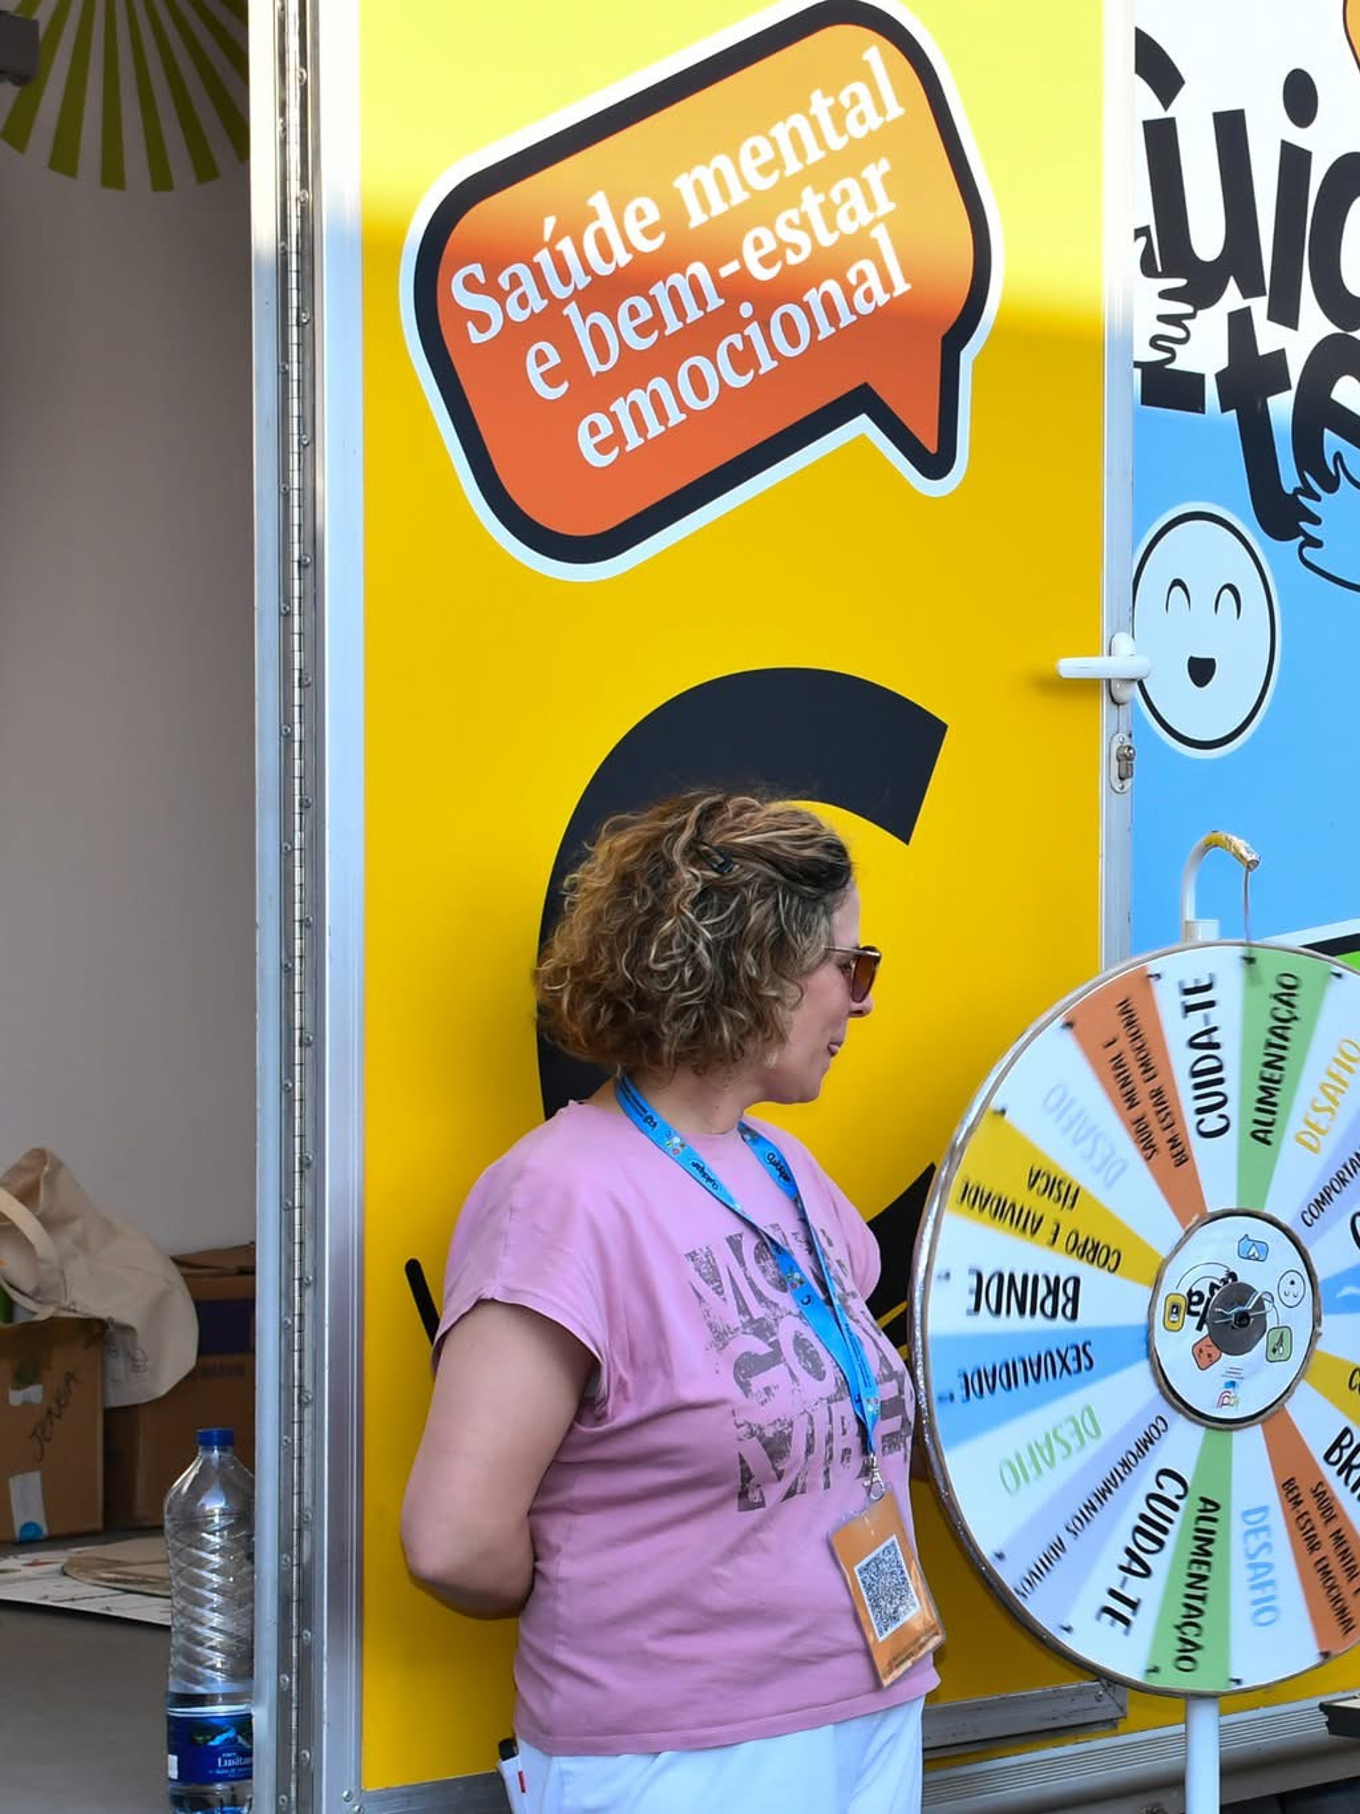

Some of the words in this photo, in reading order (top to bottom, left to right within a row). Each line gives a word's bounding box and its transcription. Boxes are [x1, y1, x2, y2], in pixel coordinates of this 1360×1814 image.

[450, 190, 667, 344] Saúde
[672, 45, 905, 229] mental
[524, 341, 569, 401] e
[563, 157, 897, 379] bem-estar
[576, 222, 912, 468] emocional
[1108, 1049, 1141, 1112] MENTAL
[1115, 996, 1159, 1083] EMOCIONAL
[1178, 972, 1231, 1139] CUIDA-TE
[1249, 972, 1300, 1147] ALIMENTAÇÃO
[1041, 1083, 1128, 1191] DESAFIO
[1148, 1084, 1189, 1168] BEM-ESTAR
[958, 1175, 1044, 1237] ATIVIDADE
[1027, 1164, 1081, 1212] FÍSICA
[1050, 1221, 1061, 1246] E
[966, 1268, 1081, 1321] BRINDE
[1064, 1228, 1122, 1274] CORPO
[959, 1341, 1094, 1401] SEXUALIDADE
[1000, 1404, 1102, 1494] DESAFIO
[1065, 1414, 1169, 1540] COMPORTAMENTOS
[1013, 1534, 1066, 1599] ADITIVOS
[1096, 1467, 1189, 1637] CUIDA-TE
[1174, 1495, 1221, 1673] ALIMENTAÇÃO
[1241, 1504, 1281, 1628] DESAFIO
[1282, 1477, 1324, 1556] BEM-ESTAR
[1314, 1557, 1356, 1637] EMOCIONAL
